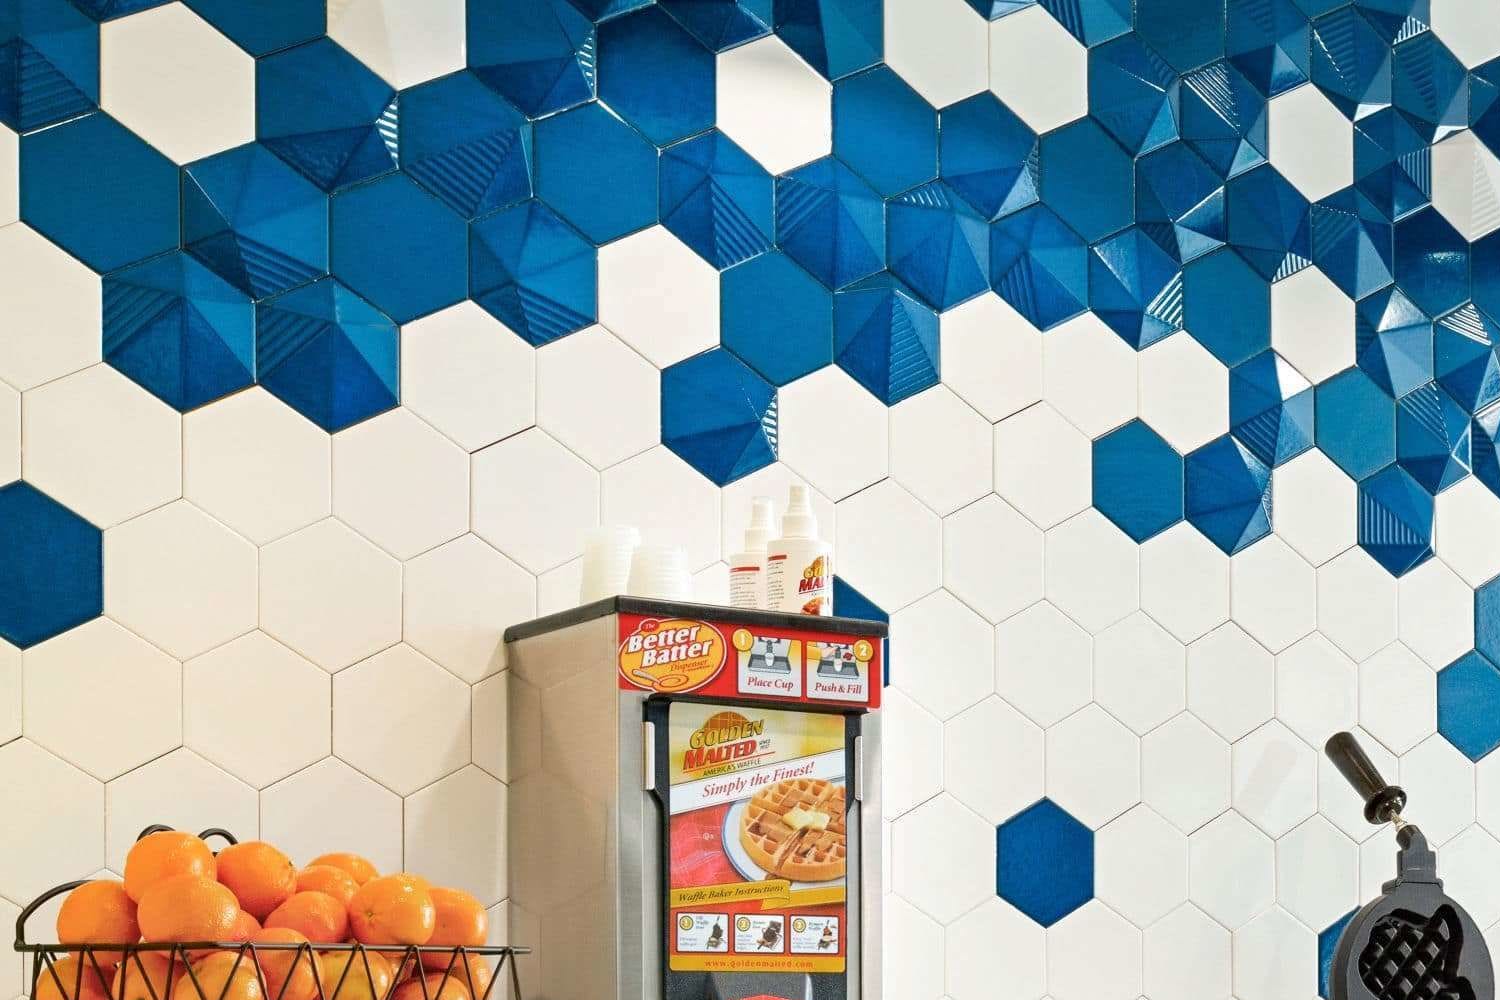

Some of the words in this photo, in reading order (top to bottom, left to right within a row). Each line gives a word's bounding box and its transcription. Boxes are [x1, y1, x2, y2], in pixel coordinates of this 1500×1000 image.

[627, 625, 700, 653] Better
[641, 640, 712, 667] Batter
[859, 645, 867, 657] 2
[747, 676, 772, 688] Place
[774, 679, 794, 692] Cup
[815, 682, 837, 694] Push
[837, 684, 846, 694] &
[847, 684, 862, 694] Fill
[689, 719, 764, 750] GOLDEN
[682, 739, 757, 770] MALTED
[702, 764, 736, 777] AMERICA'S
[736, 758, 761, 770] WAFFLE
[702, 777, 747, 798] Simply
[750, 771, 768, 787] the
[773, 761, 815, 783] Finest!
[679, 892, 707, 902] Waffle
[708, 889, 733, 900] Baker
[734, 884, 785, 896] Instructions
